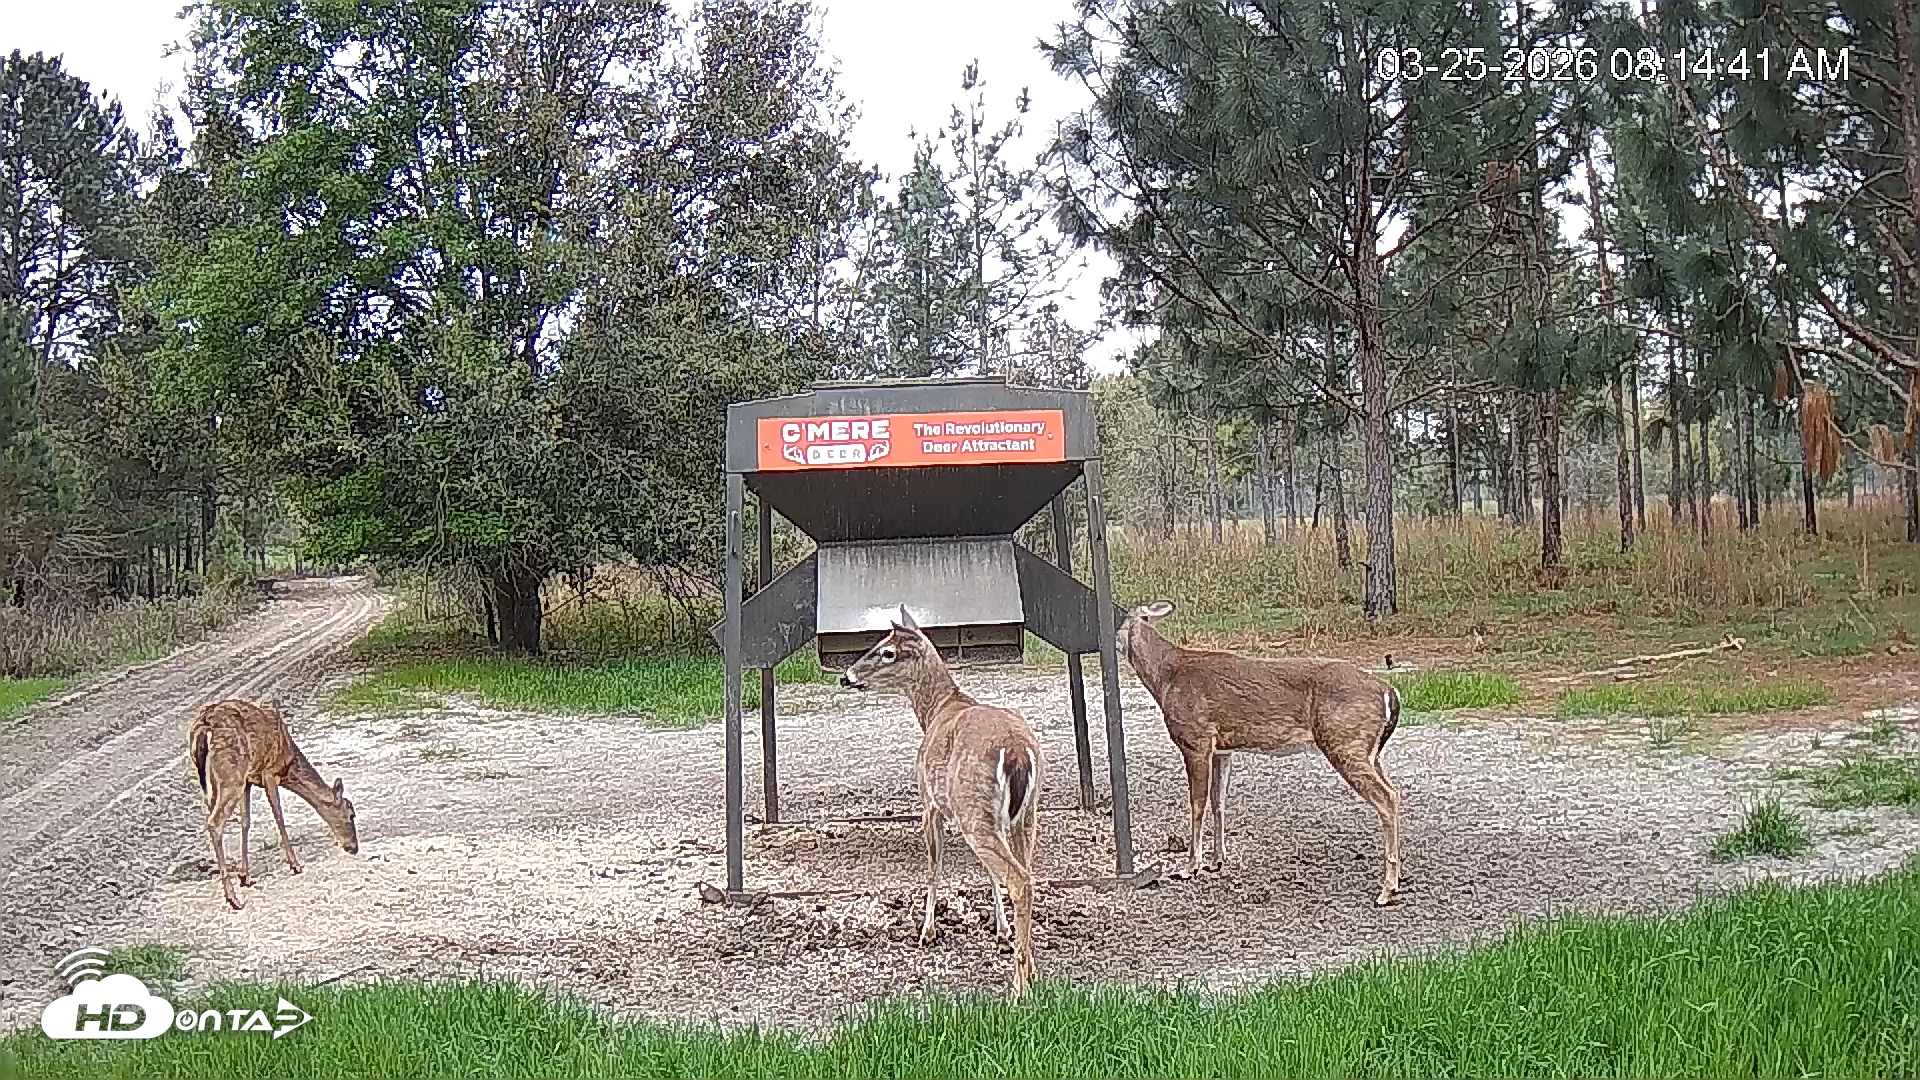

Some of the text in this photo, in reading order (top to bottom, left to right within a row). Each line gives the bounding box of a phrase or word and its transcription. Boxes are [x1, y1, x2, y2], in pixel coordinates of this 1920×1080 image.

[782, 420, 890, 442] C'MERE
[913, 421, 1045, 436] The Revolutionary
[922, 438, 1035, 453] Deer Attractant
[812, 448, 861, 460] DEER
